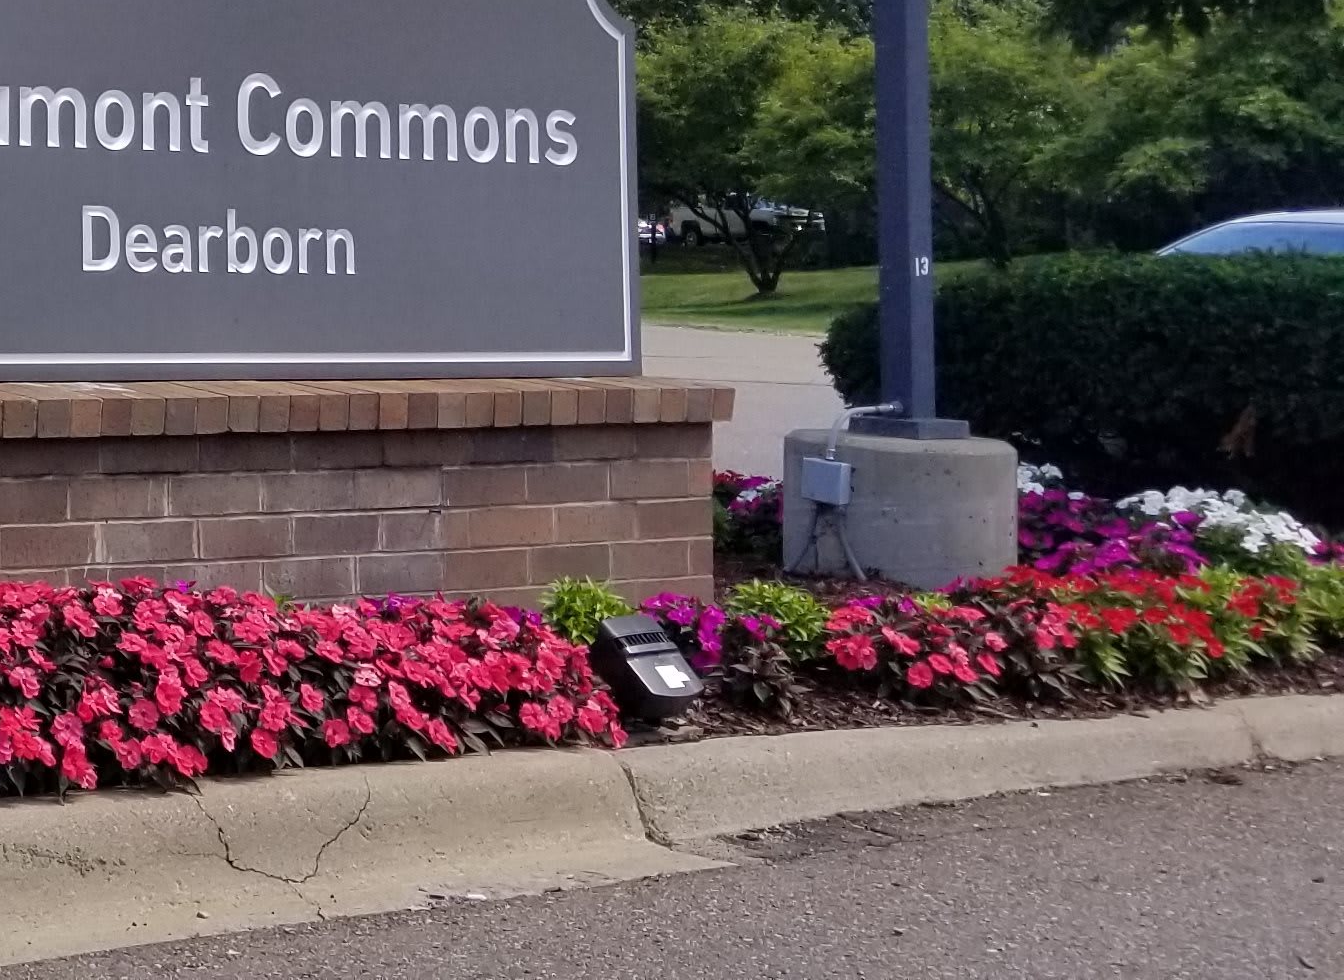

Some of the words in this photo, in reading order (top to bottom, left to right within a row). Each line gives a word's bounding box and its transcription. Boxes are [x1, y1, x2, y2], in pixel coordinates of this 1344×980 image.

[237, 72, 579, 166] Commons
[81, 204, 356, 275] Dearborn
[914, 256, 929, 277] 13
